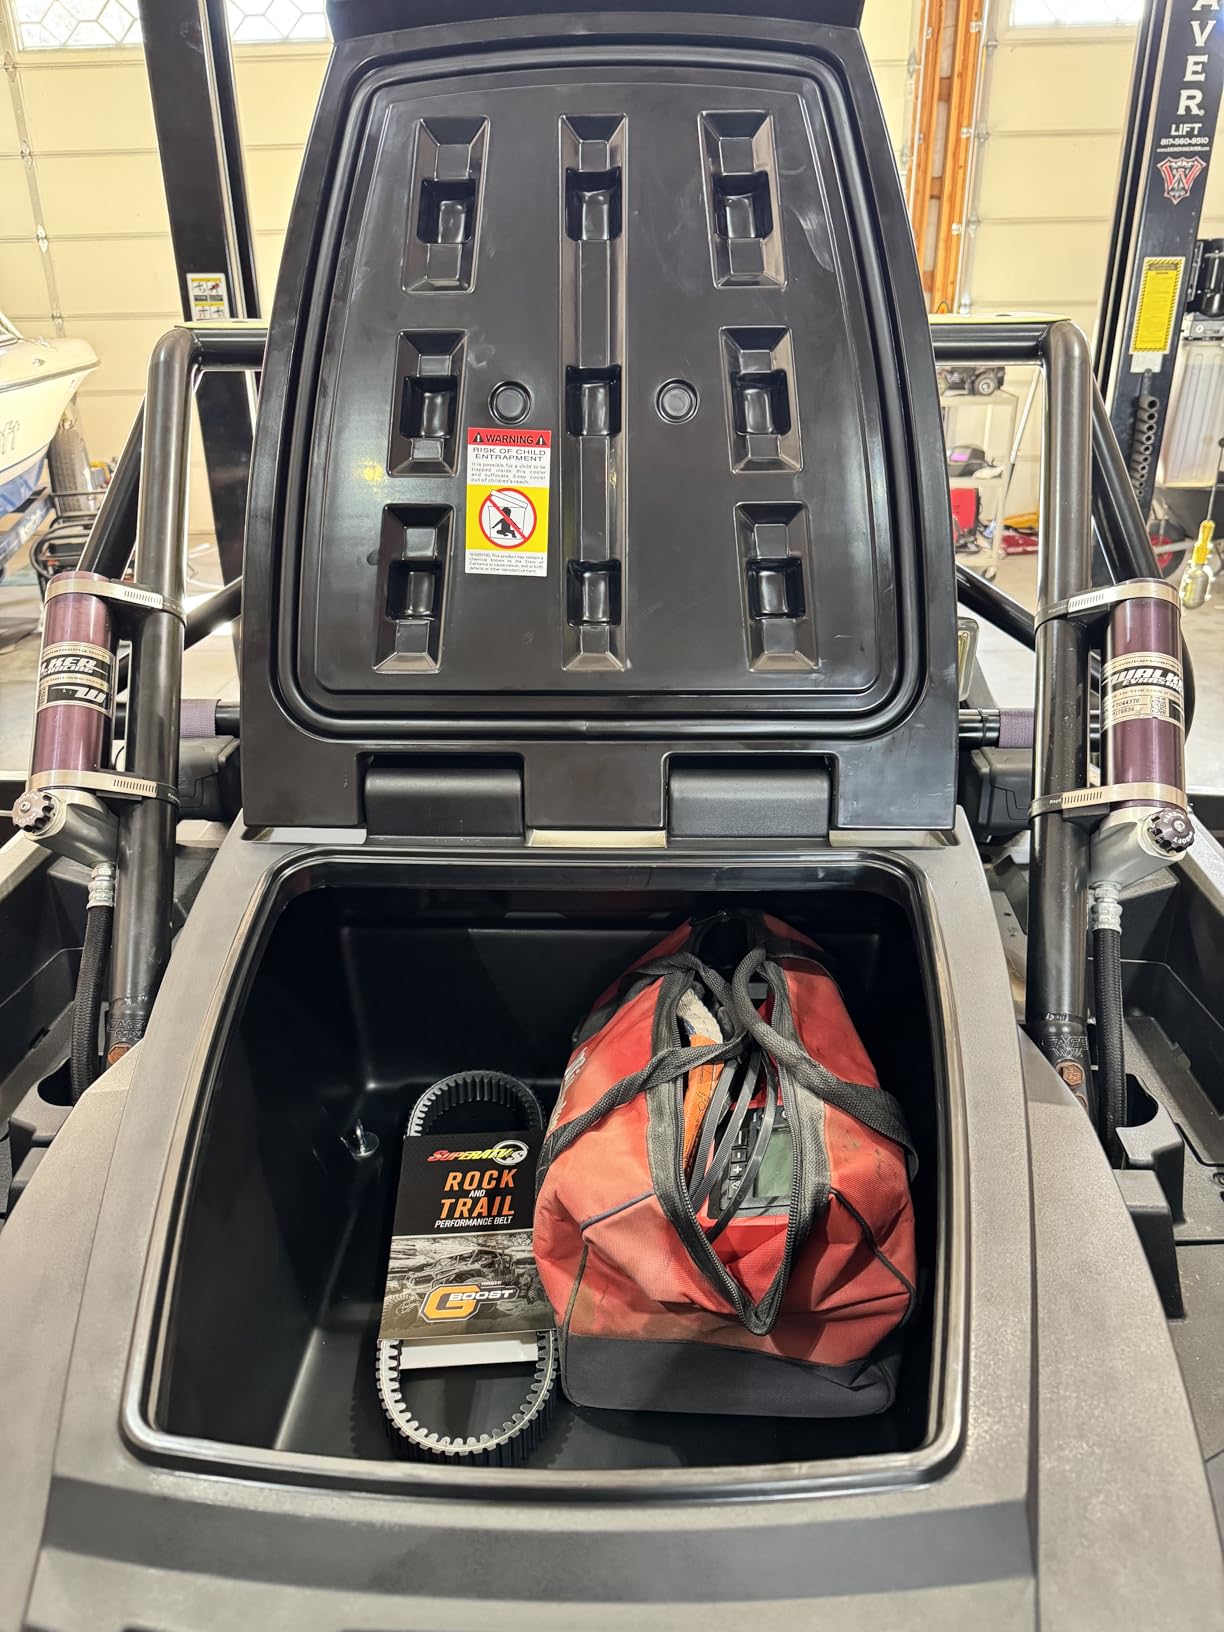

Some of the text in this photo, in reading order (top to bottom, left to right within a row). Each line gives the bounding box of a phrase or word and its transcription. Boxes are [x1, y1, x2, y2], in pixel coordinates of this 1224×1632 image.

[1170, 123, 1202, 136] LIFT
[486, 434, 534, 444] WARNING
[444, 1168, 518, 1192] ROCK
[468, 1190, 486, 1198] AND
[440, 1195, 514, 1219] TRAIL
[434, 1216, 513, 1228] PERFORMANCE BELT
[449, 1290, 514, 1300] BOOST
